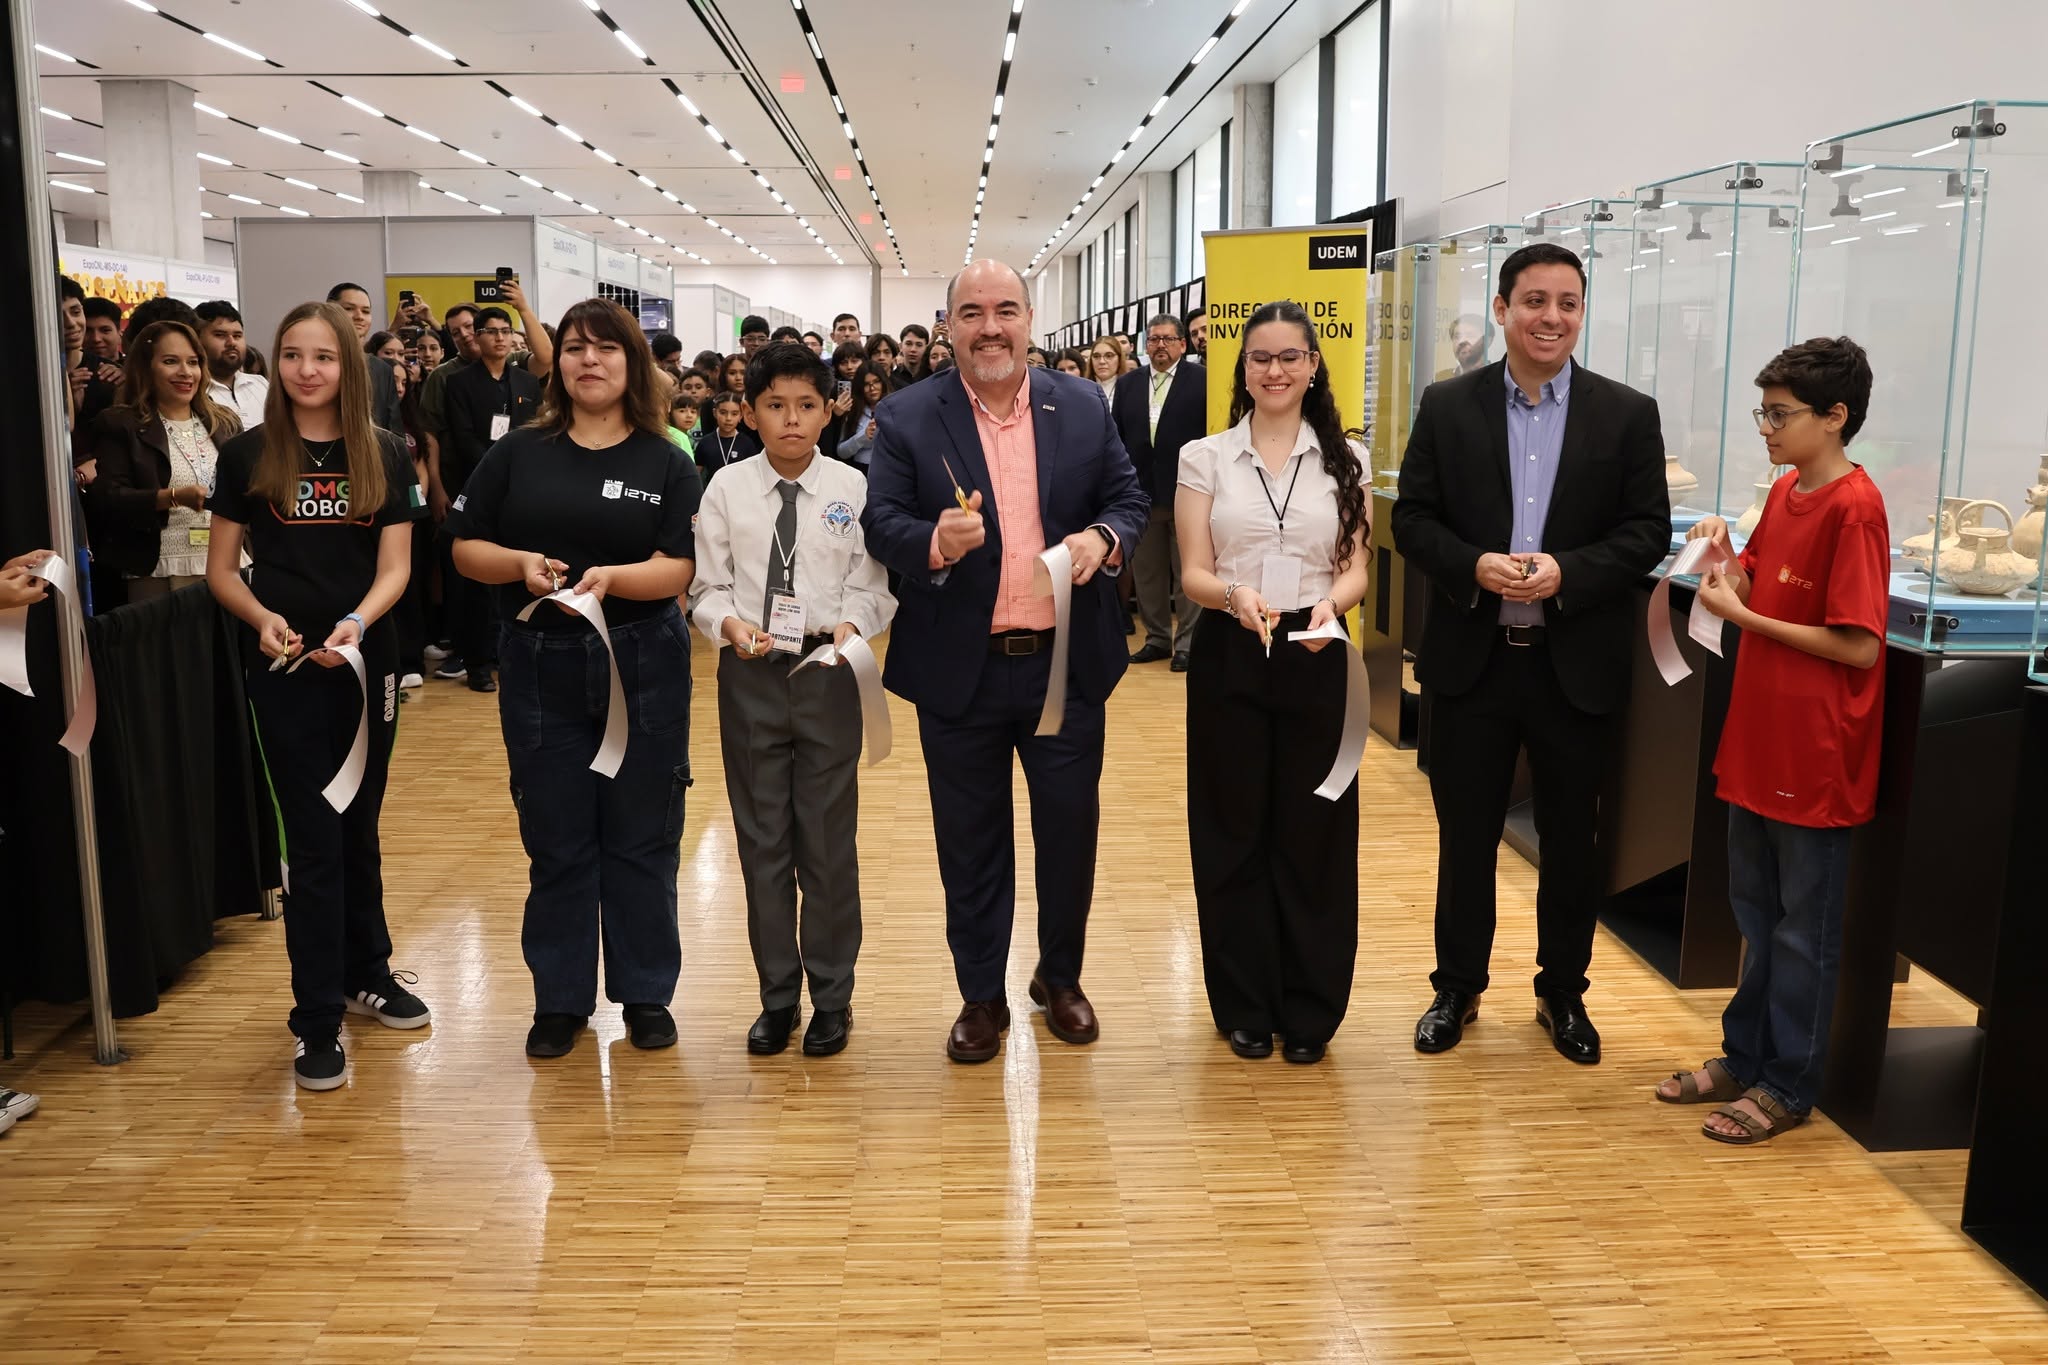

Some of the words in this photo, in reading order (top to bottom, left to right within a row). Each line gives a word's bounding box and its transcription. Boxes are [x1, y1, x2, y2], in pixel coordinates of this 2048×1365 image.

[1317, 246, 1358, 259] UDEM
[481, 287, 497, 296] UD
[1314, 301, 1338, 317] DE
[294, 500, 350, 517] ROBO
